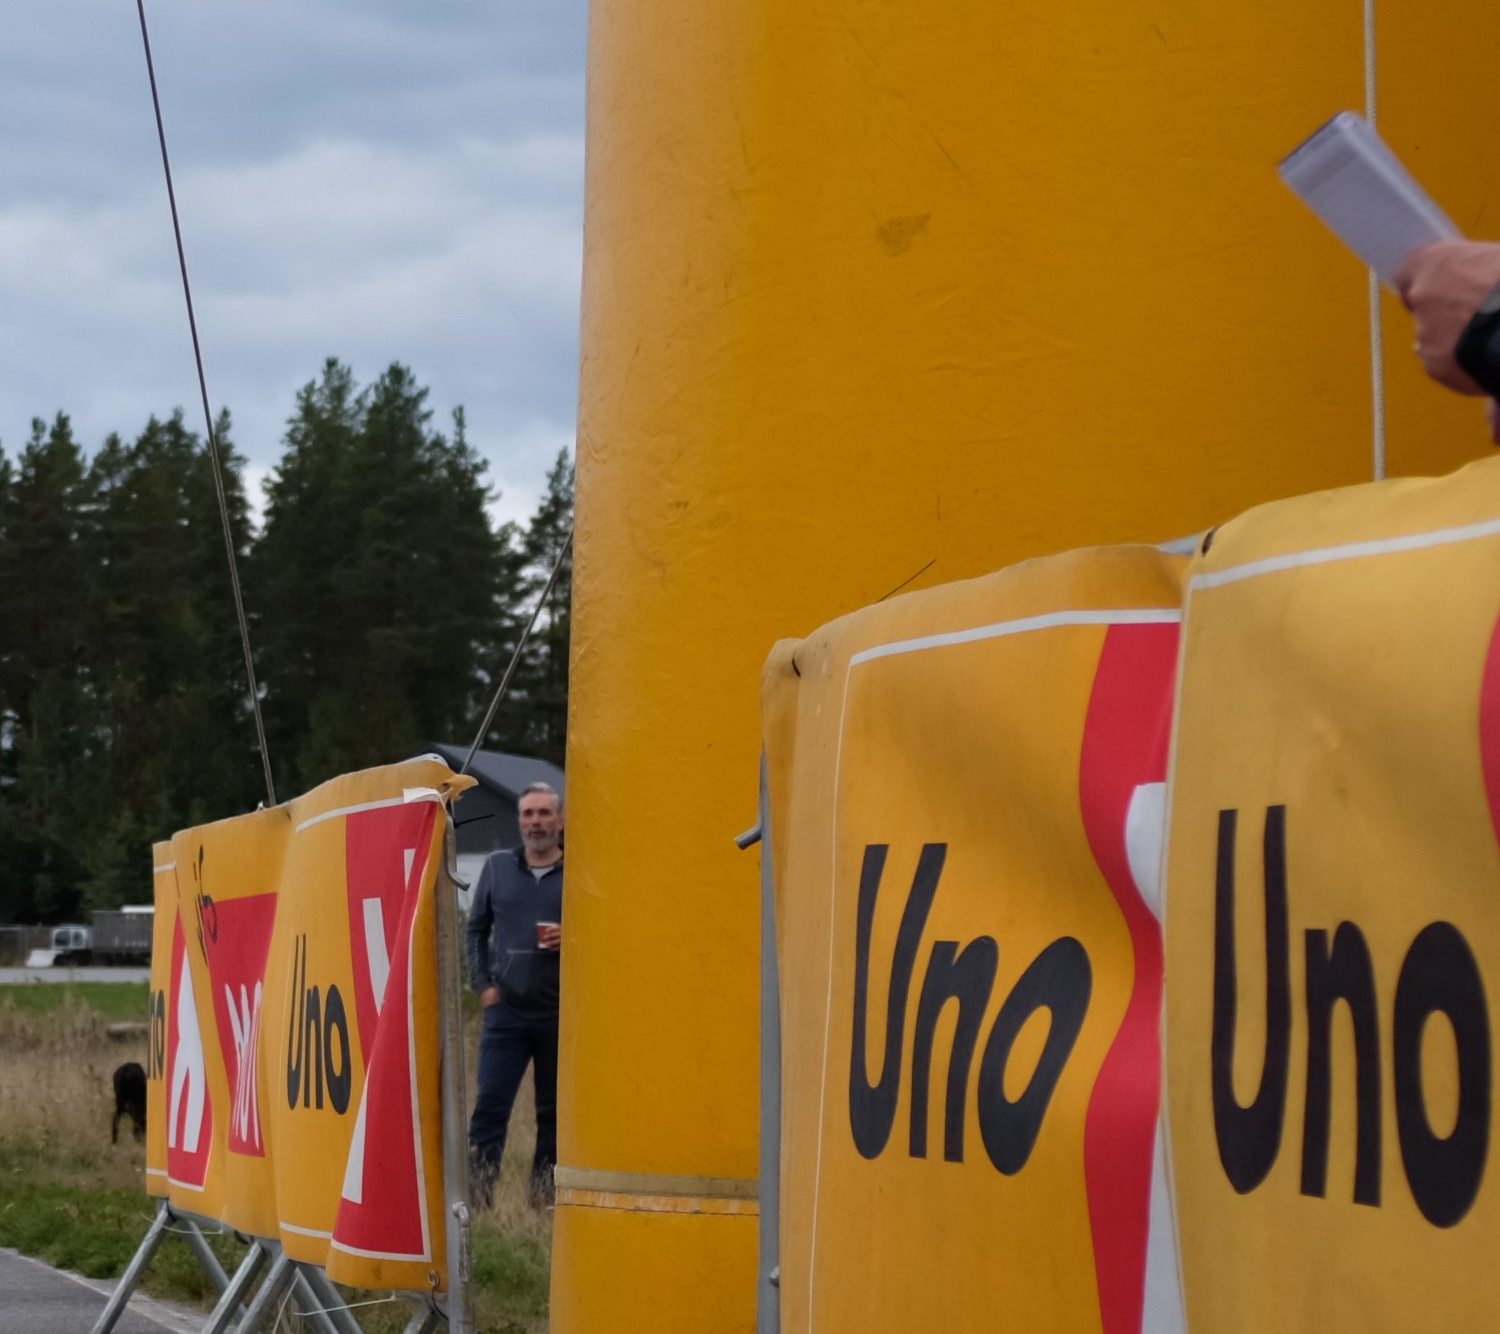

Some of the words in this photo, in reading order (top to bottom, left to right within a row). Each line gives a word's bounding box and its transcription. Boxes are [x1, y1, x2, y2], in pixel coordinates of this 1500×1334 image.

[287, 932, 352, 1115] Uno
[850, 840, 1092, 1177] Uno
[1211, 804, 1491, 1229] Uno
